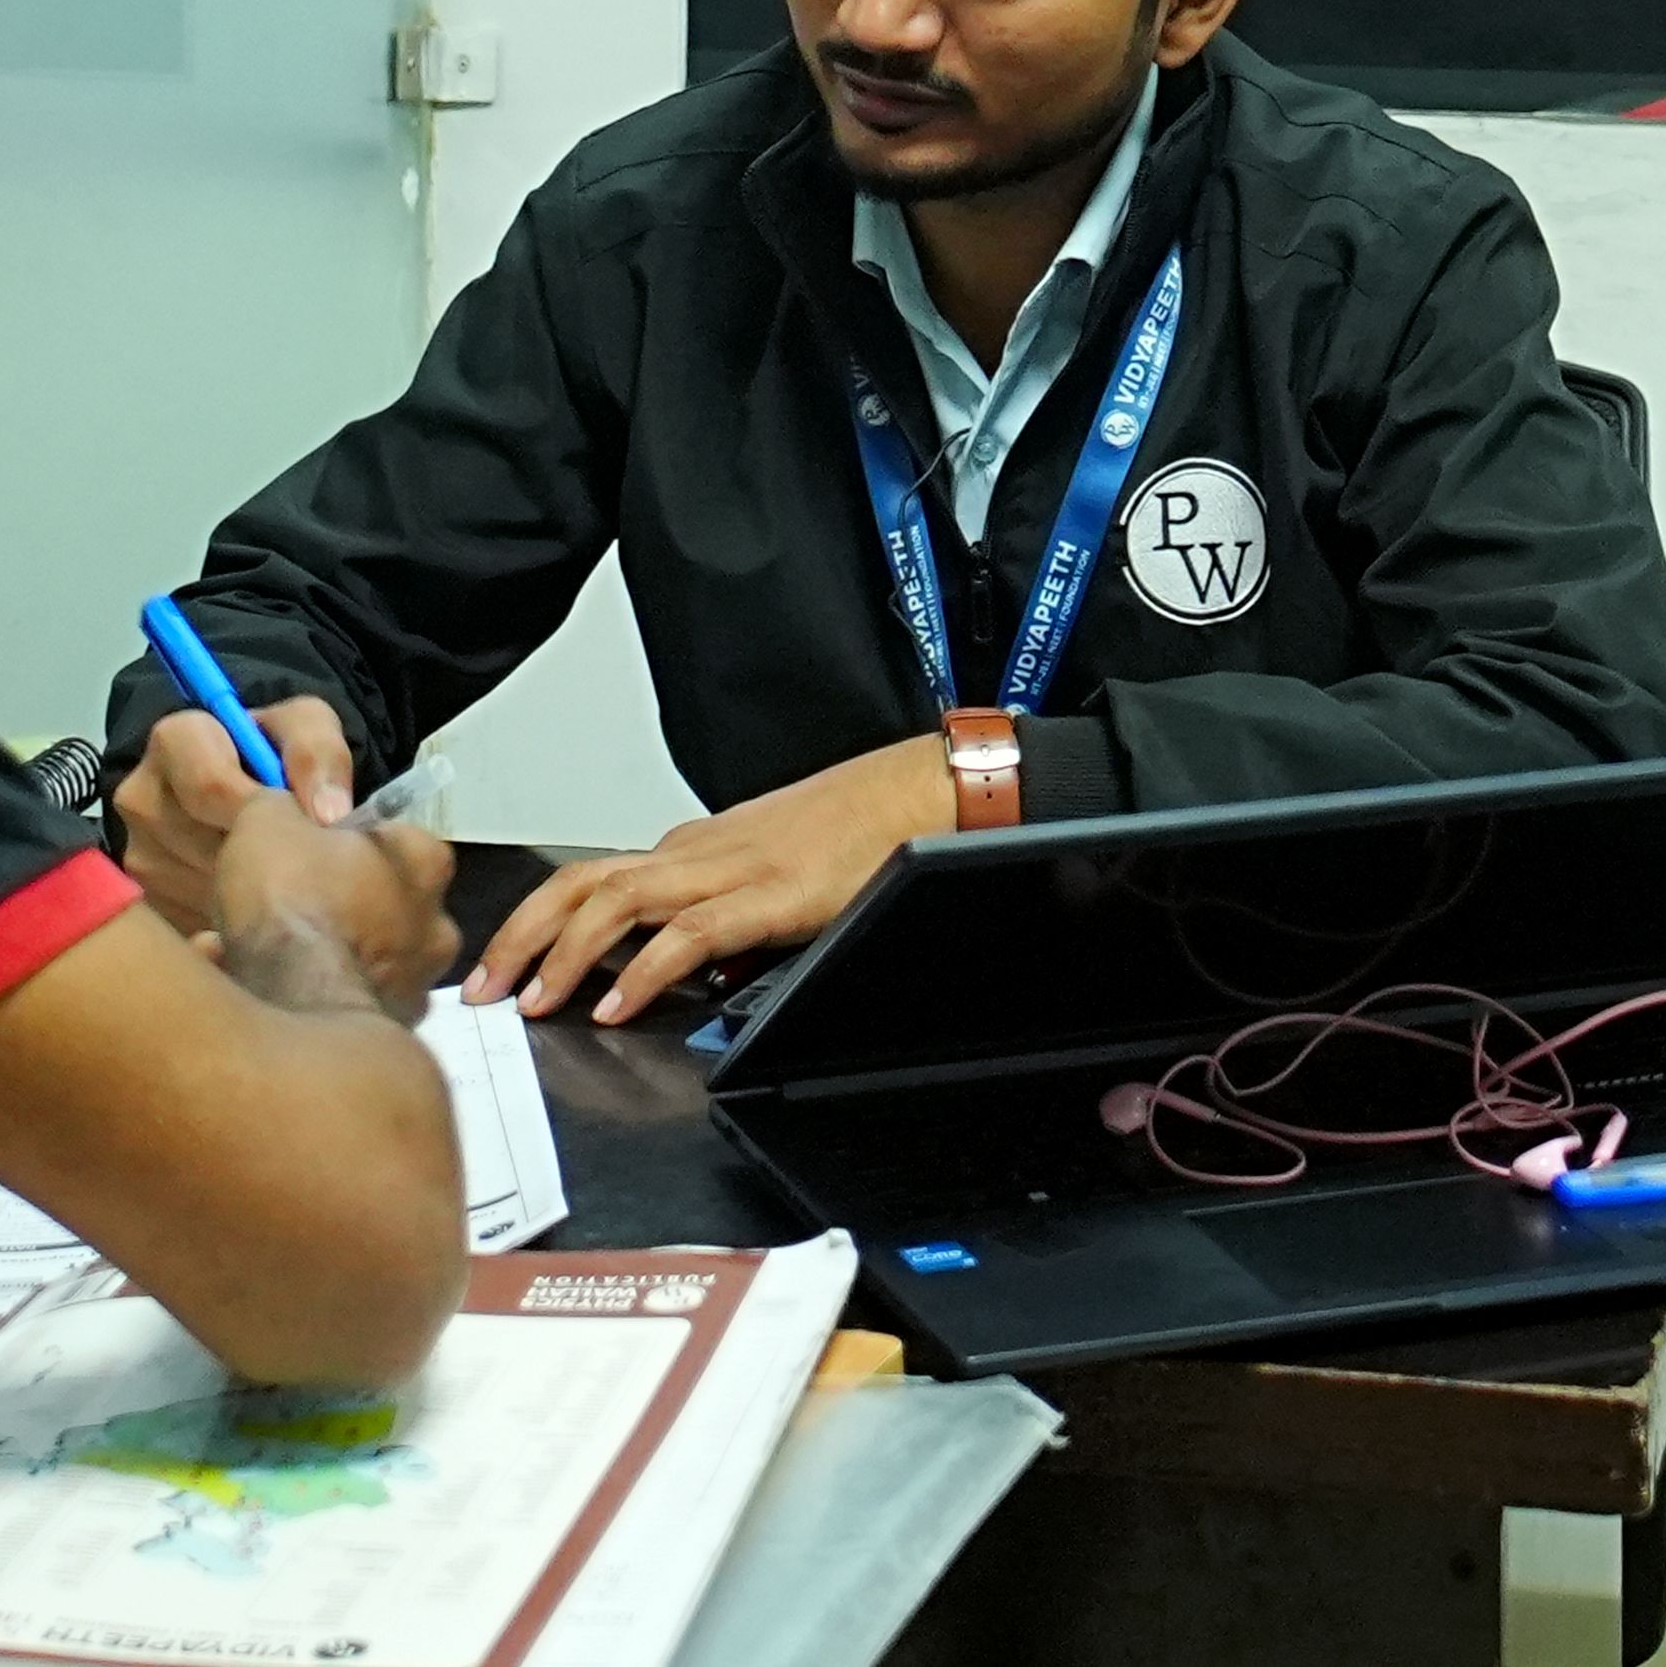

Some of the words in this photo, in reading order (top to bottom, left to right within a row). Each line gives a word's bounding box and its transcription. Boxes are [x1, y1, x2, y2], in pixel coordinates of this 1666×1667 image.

[1113, 256, 1181, 405] VIDYAPEETH
[1059, 548, 1092, 622] FOUNDATION
[1007, 539, 1078, 694] VIDYAPEETH
[525, 1286, 638, 1299] WALLAH
[533, 1272, 717, 1286] PUBLICATION
[519, 1297, 633, 1312] PHYSICS
[39, 1625, 296, 1659] VIDYAPEETH
